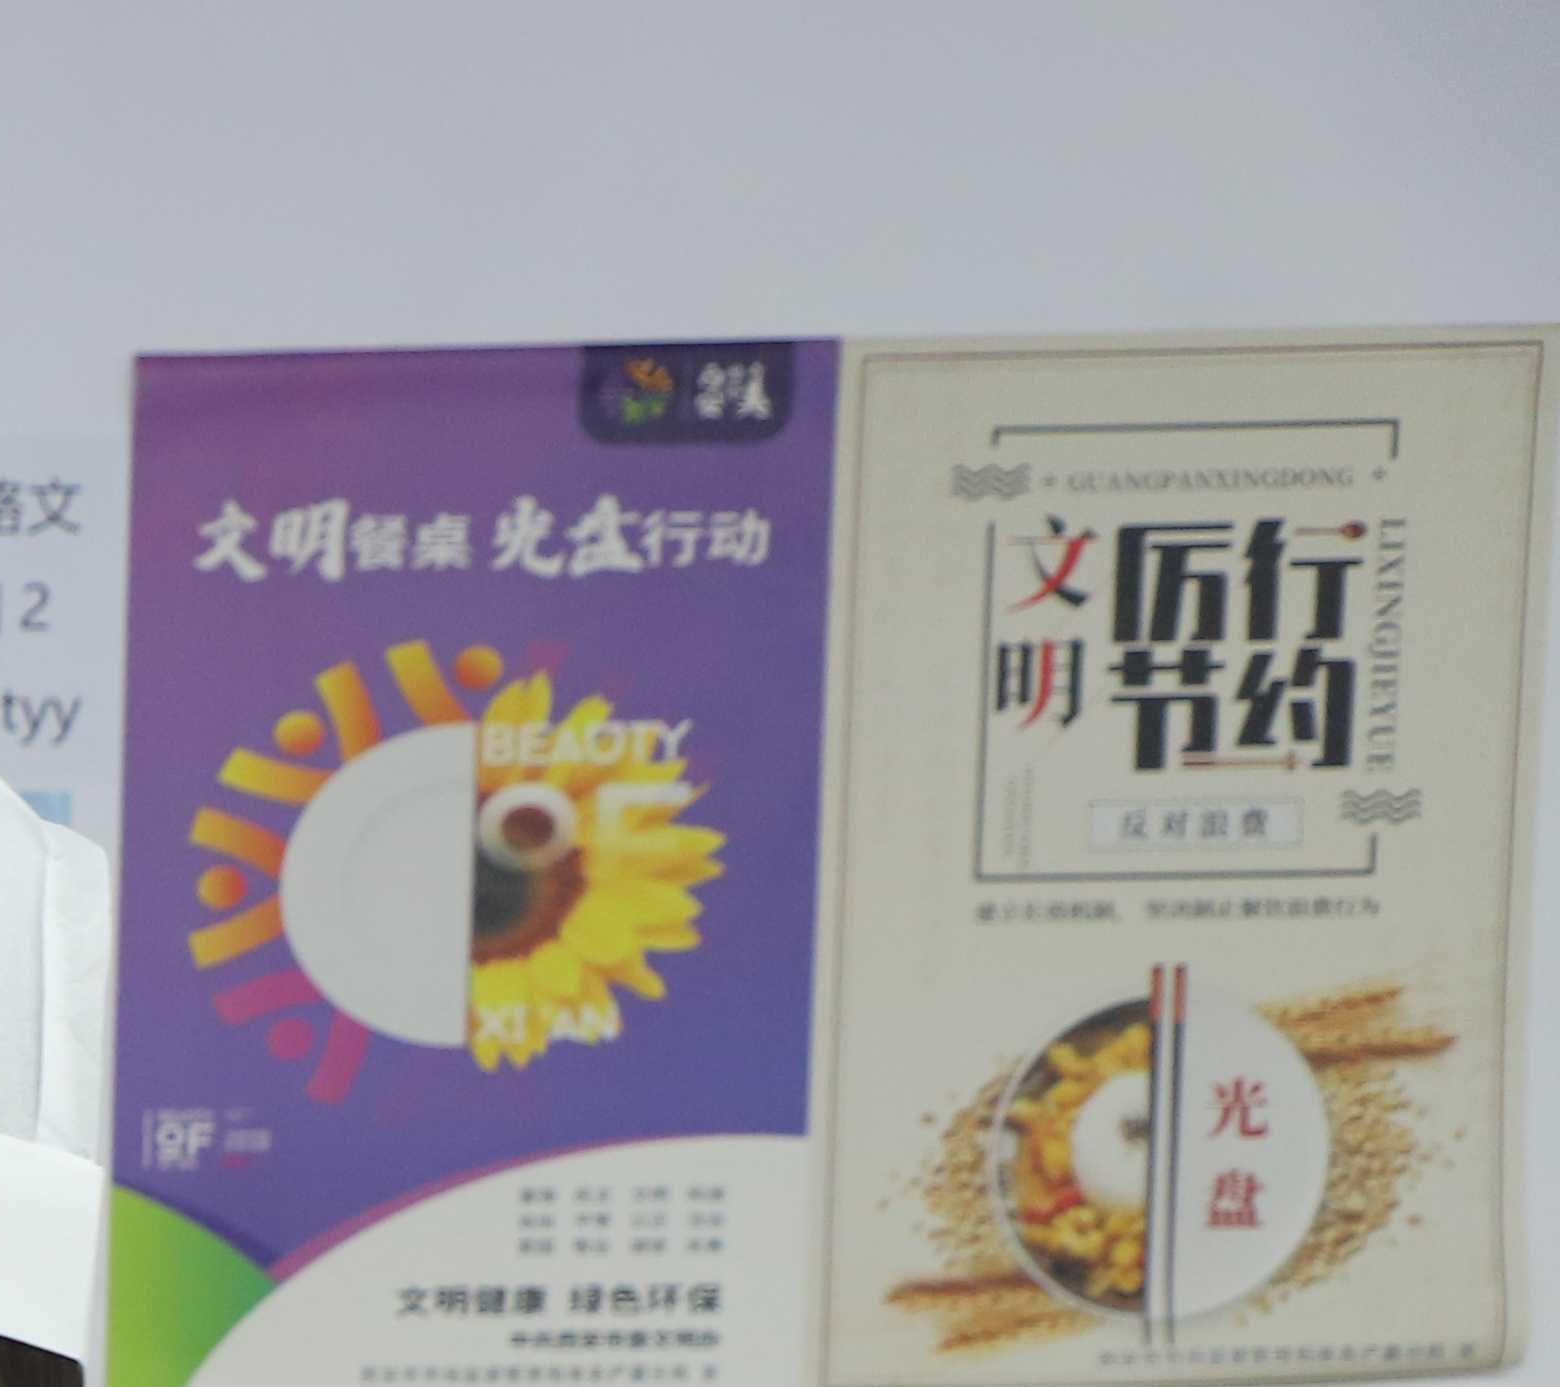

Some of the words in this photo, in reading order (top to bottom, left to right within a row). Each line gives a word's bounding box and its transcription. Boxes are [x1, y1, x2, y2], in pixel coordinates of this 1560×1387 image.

[194, 498, 474, 582] 文明餐桌
[491, 493, 773, 578] 光盘行动
[1111, 517, 1368, 643] 厉行
[19, 581, 52, 633] 2
[1105, 645, 1356, 772] 节约
